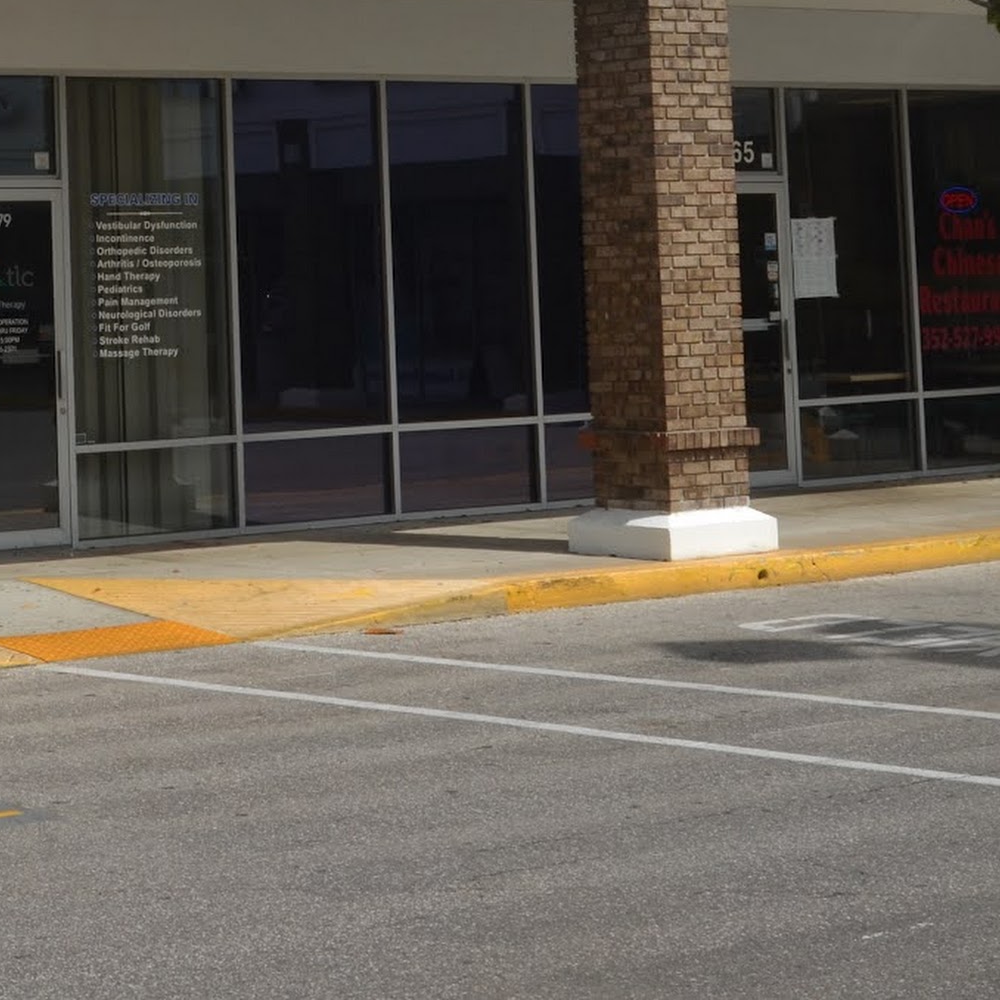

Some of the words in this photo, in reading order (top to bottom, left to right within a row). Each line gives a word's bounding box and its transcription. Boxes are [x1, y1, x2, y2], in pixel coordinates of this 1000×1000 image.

[90, 192, 181, 206] SPECIALIZING
[183, 192, 199, 206] IN
[95, 220, 142, 230] Vestibular
[144, 220, 198, 232] Dysfunction
[96, 233, 155, 243] Incontinence
[96, 246, 148, 257] Orthopedic
[150, 246, 193, 255] Disorders
[97, 259, 134, 268] Arthritis
[142, 258, 202, 269] Osteoporosis
[6, 264, 34, 287] tlc
[97, 272, 121, 281] Hand
[124, 271, 161, 282] Therapy
[97, 284, 143, 294] Pediatrics
[98, 297, 119, 307] Pain
[121, 297, 179, 308] Management
[98, 309, 156, 321] Neurological
[158, 308, 202, 318] Disorders
[98, 322, 111, 332] Fit
[113, 322, 129, 332] For
[131, 321, 151, 331] Golf
[99, 335, 130, 345] Stroke
[131, 334, 161, 344] Rehab
[99, 348, 140, 359] Massage
[142, 347, 179, 358] Therapy
